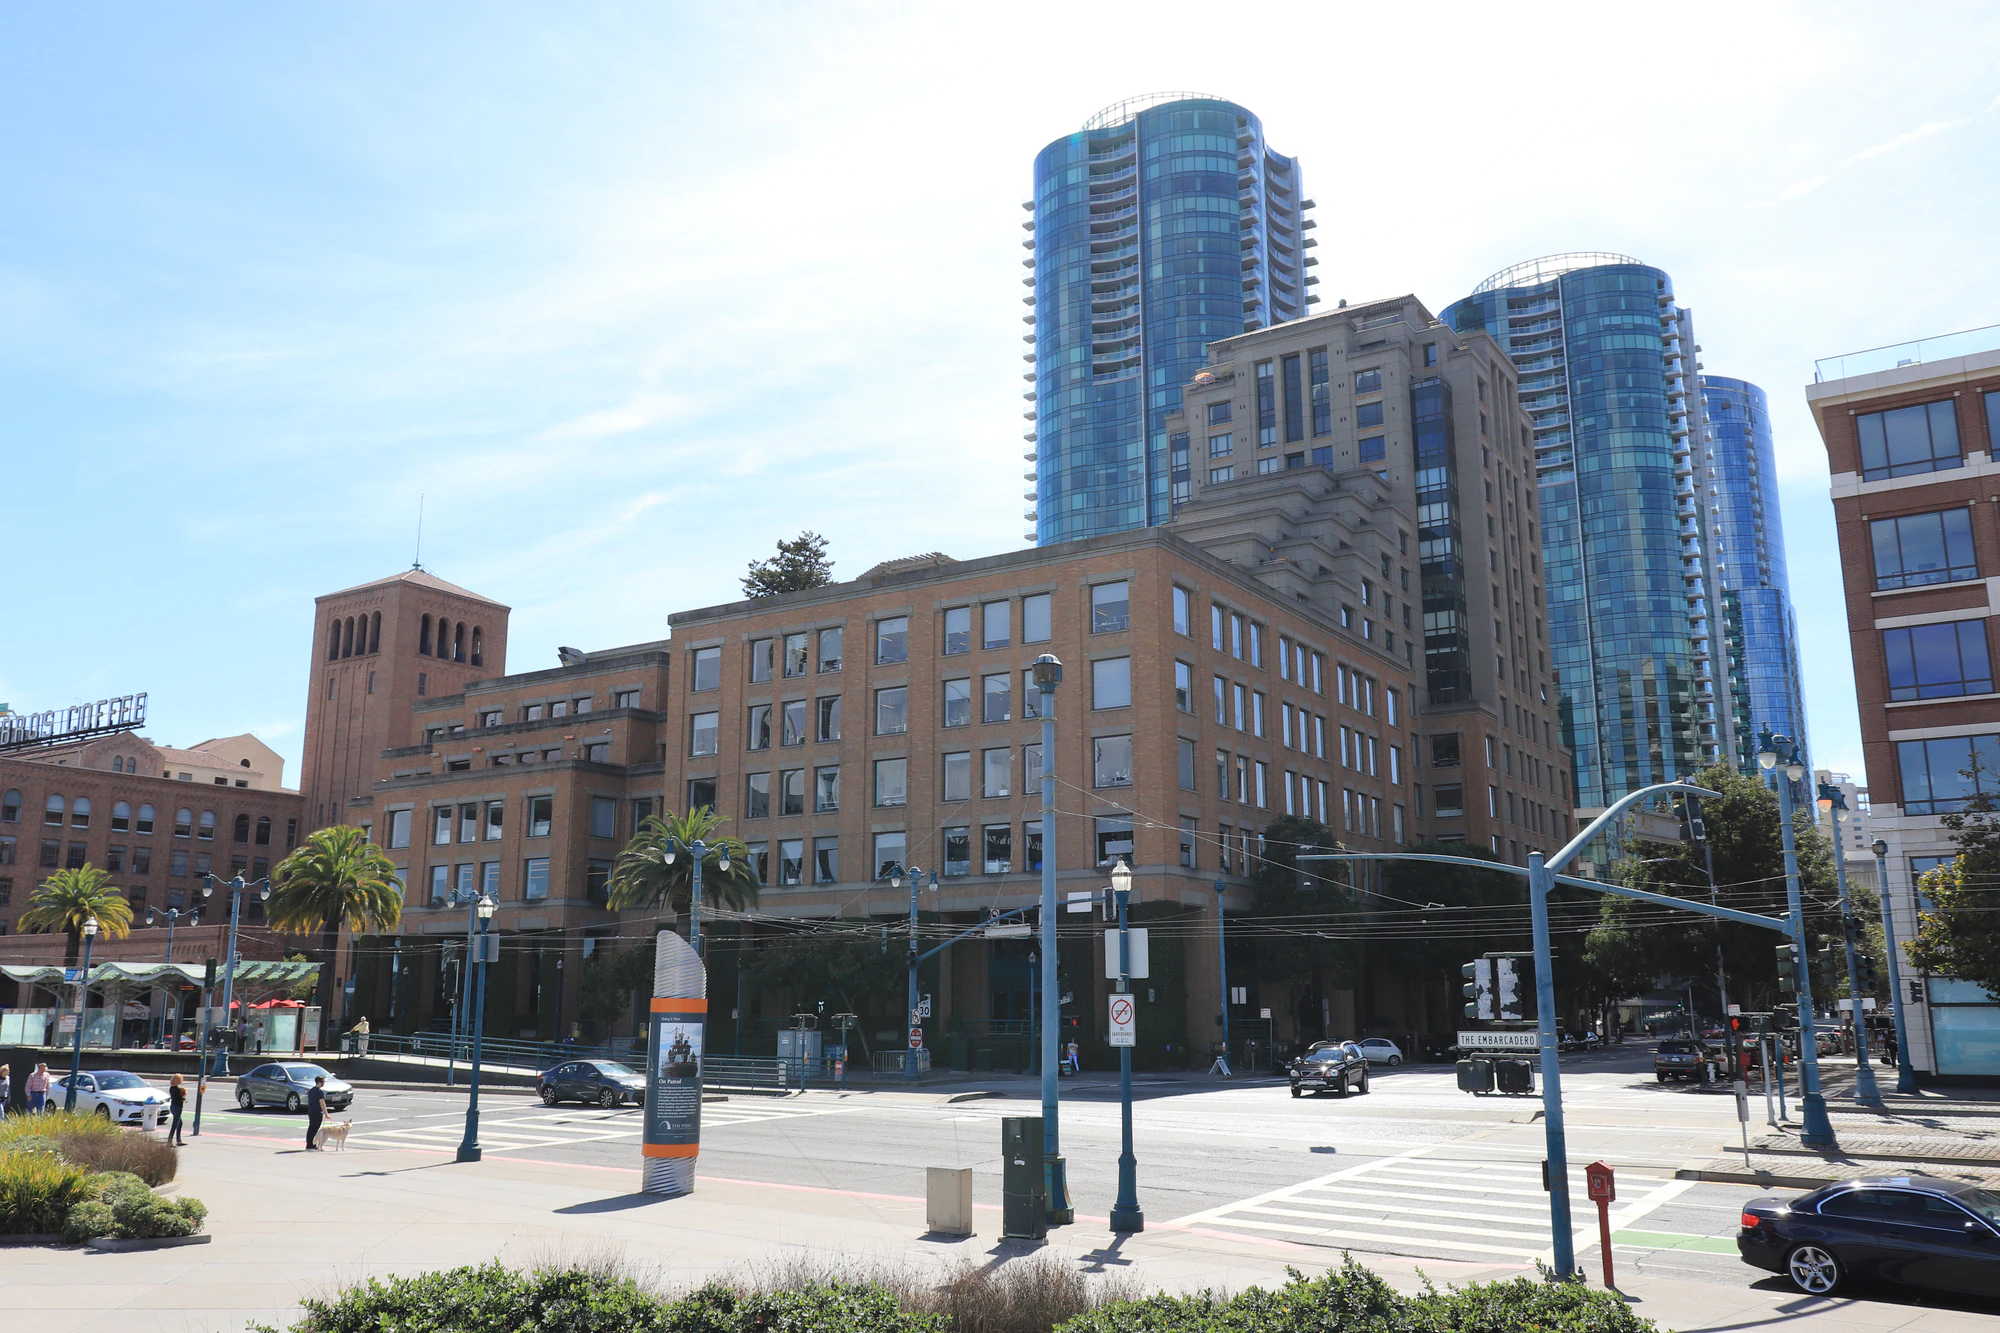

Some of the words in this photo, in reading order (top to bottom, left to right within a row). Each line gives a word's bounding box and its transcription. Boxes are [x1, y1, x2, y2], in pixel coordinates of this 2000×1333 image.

[0, 709, 54, 745] BROS
[67, 692, 147, 733] COFFEE
[920, 1006, 930, 1016] 30
[1461, 1035, 1475, 1045] THE
[1478, 1035, 1535, 1046] EMBARCADERO
